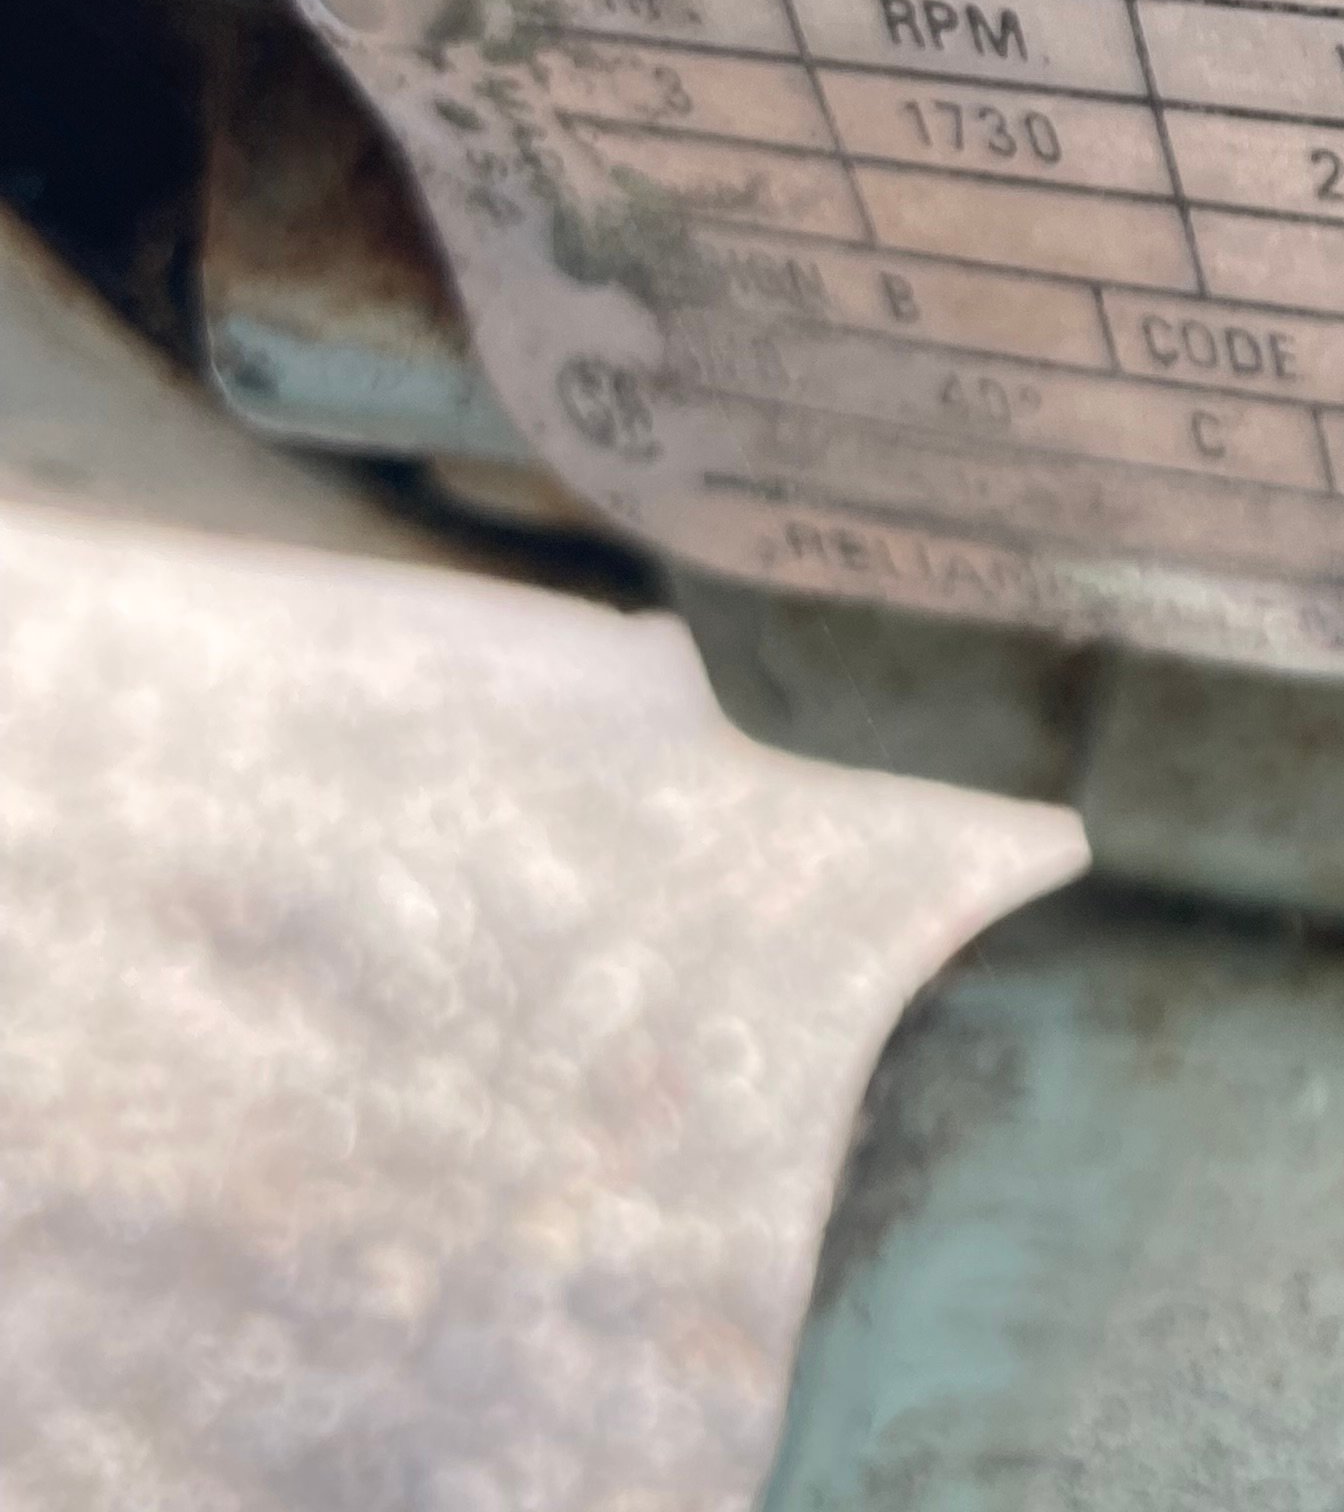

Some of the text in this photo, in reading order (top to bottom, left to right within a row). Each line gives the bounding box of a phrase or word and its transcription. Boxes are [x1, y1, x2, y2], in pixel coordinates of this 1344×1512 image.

[898, 98, 1064, 167] 1730
[879, 270, 921, 325] B
[1141, 313, 1298, 382] CODE
[1190, 409, 1228, 459] C
